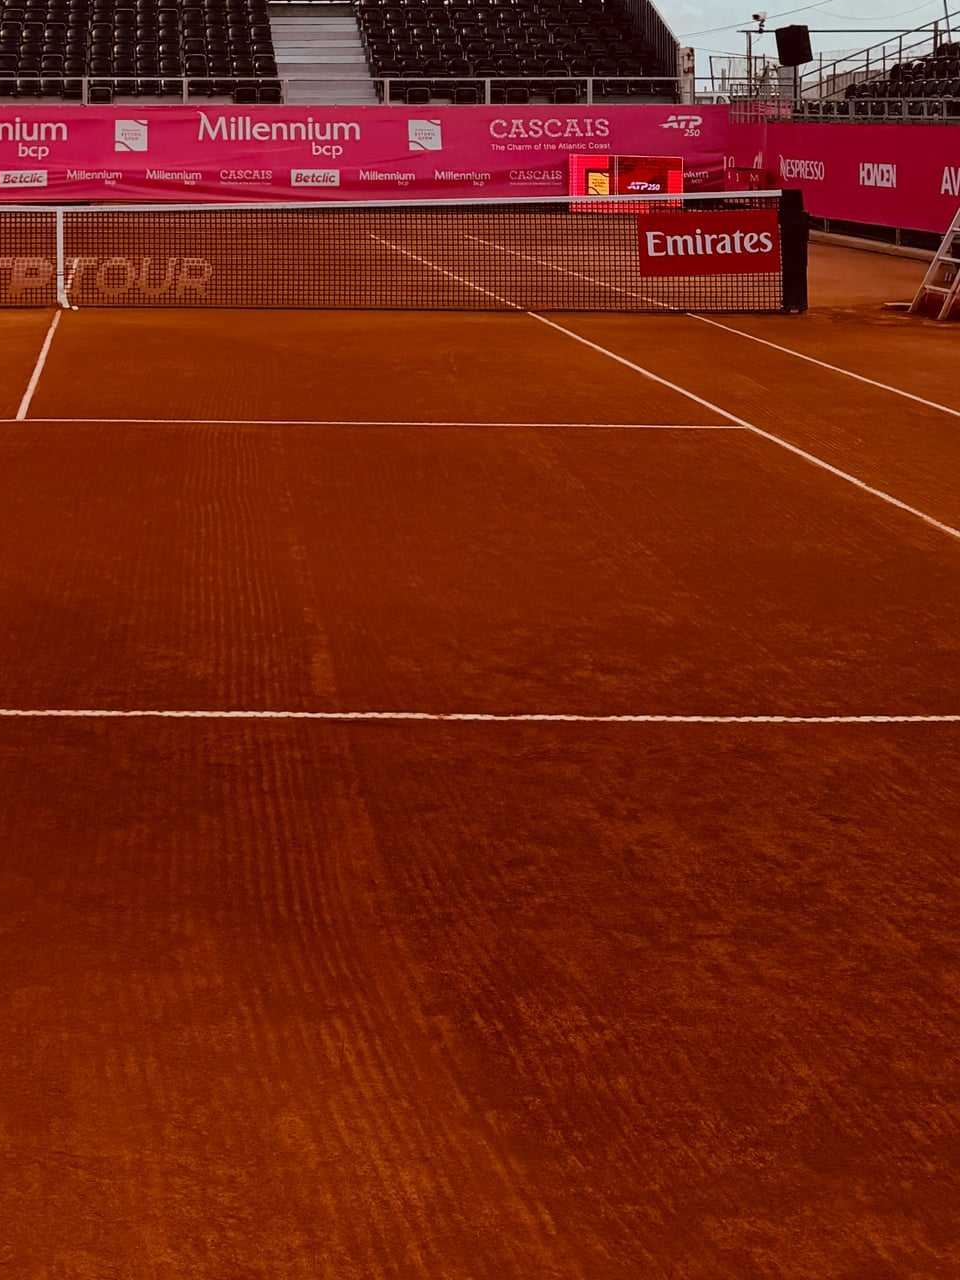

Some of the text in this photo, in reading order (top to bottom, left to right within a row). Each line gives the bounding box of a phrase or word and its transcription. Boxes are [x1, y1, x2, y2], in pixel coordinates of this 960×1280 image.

[197, 111, 361, 141] Millennium
[490, 119, 610, 138] CASCAIS
[659, 116, 703, 129] ATP
[684, 129, 700, 137] 250
[18, 143, 49, 160] bcp
[312, 142, 343, 159] bcp
[558, 142, 587, 150] Atlantic
[588, 142, 610, 150] Coast
[779, 155, 825, 181] NESPRESSO
[3, 174, 44, 184] Betclic
[66, 169, 122, 180] Millennium
[146, 169, 202, 180] Millennium
[220, 170, 272, 180] CASCAIS
[294, 173, 336, 184] Betclic
[359, 169, 415, 181] Millennium
[434, 169, 490, 181] Millennium
[509, 170, 562, 180] CASCAIS
[859, 163, 897, 188] HOWDEN
[646, 228, 773, 257] Emirates
[65, 257, 212, 296] TOUR
